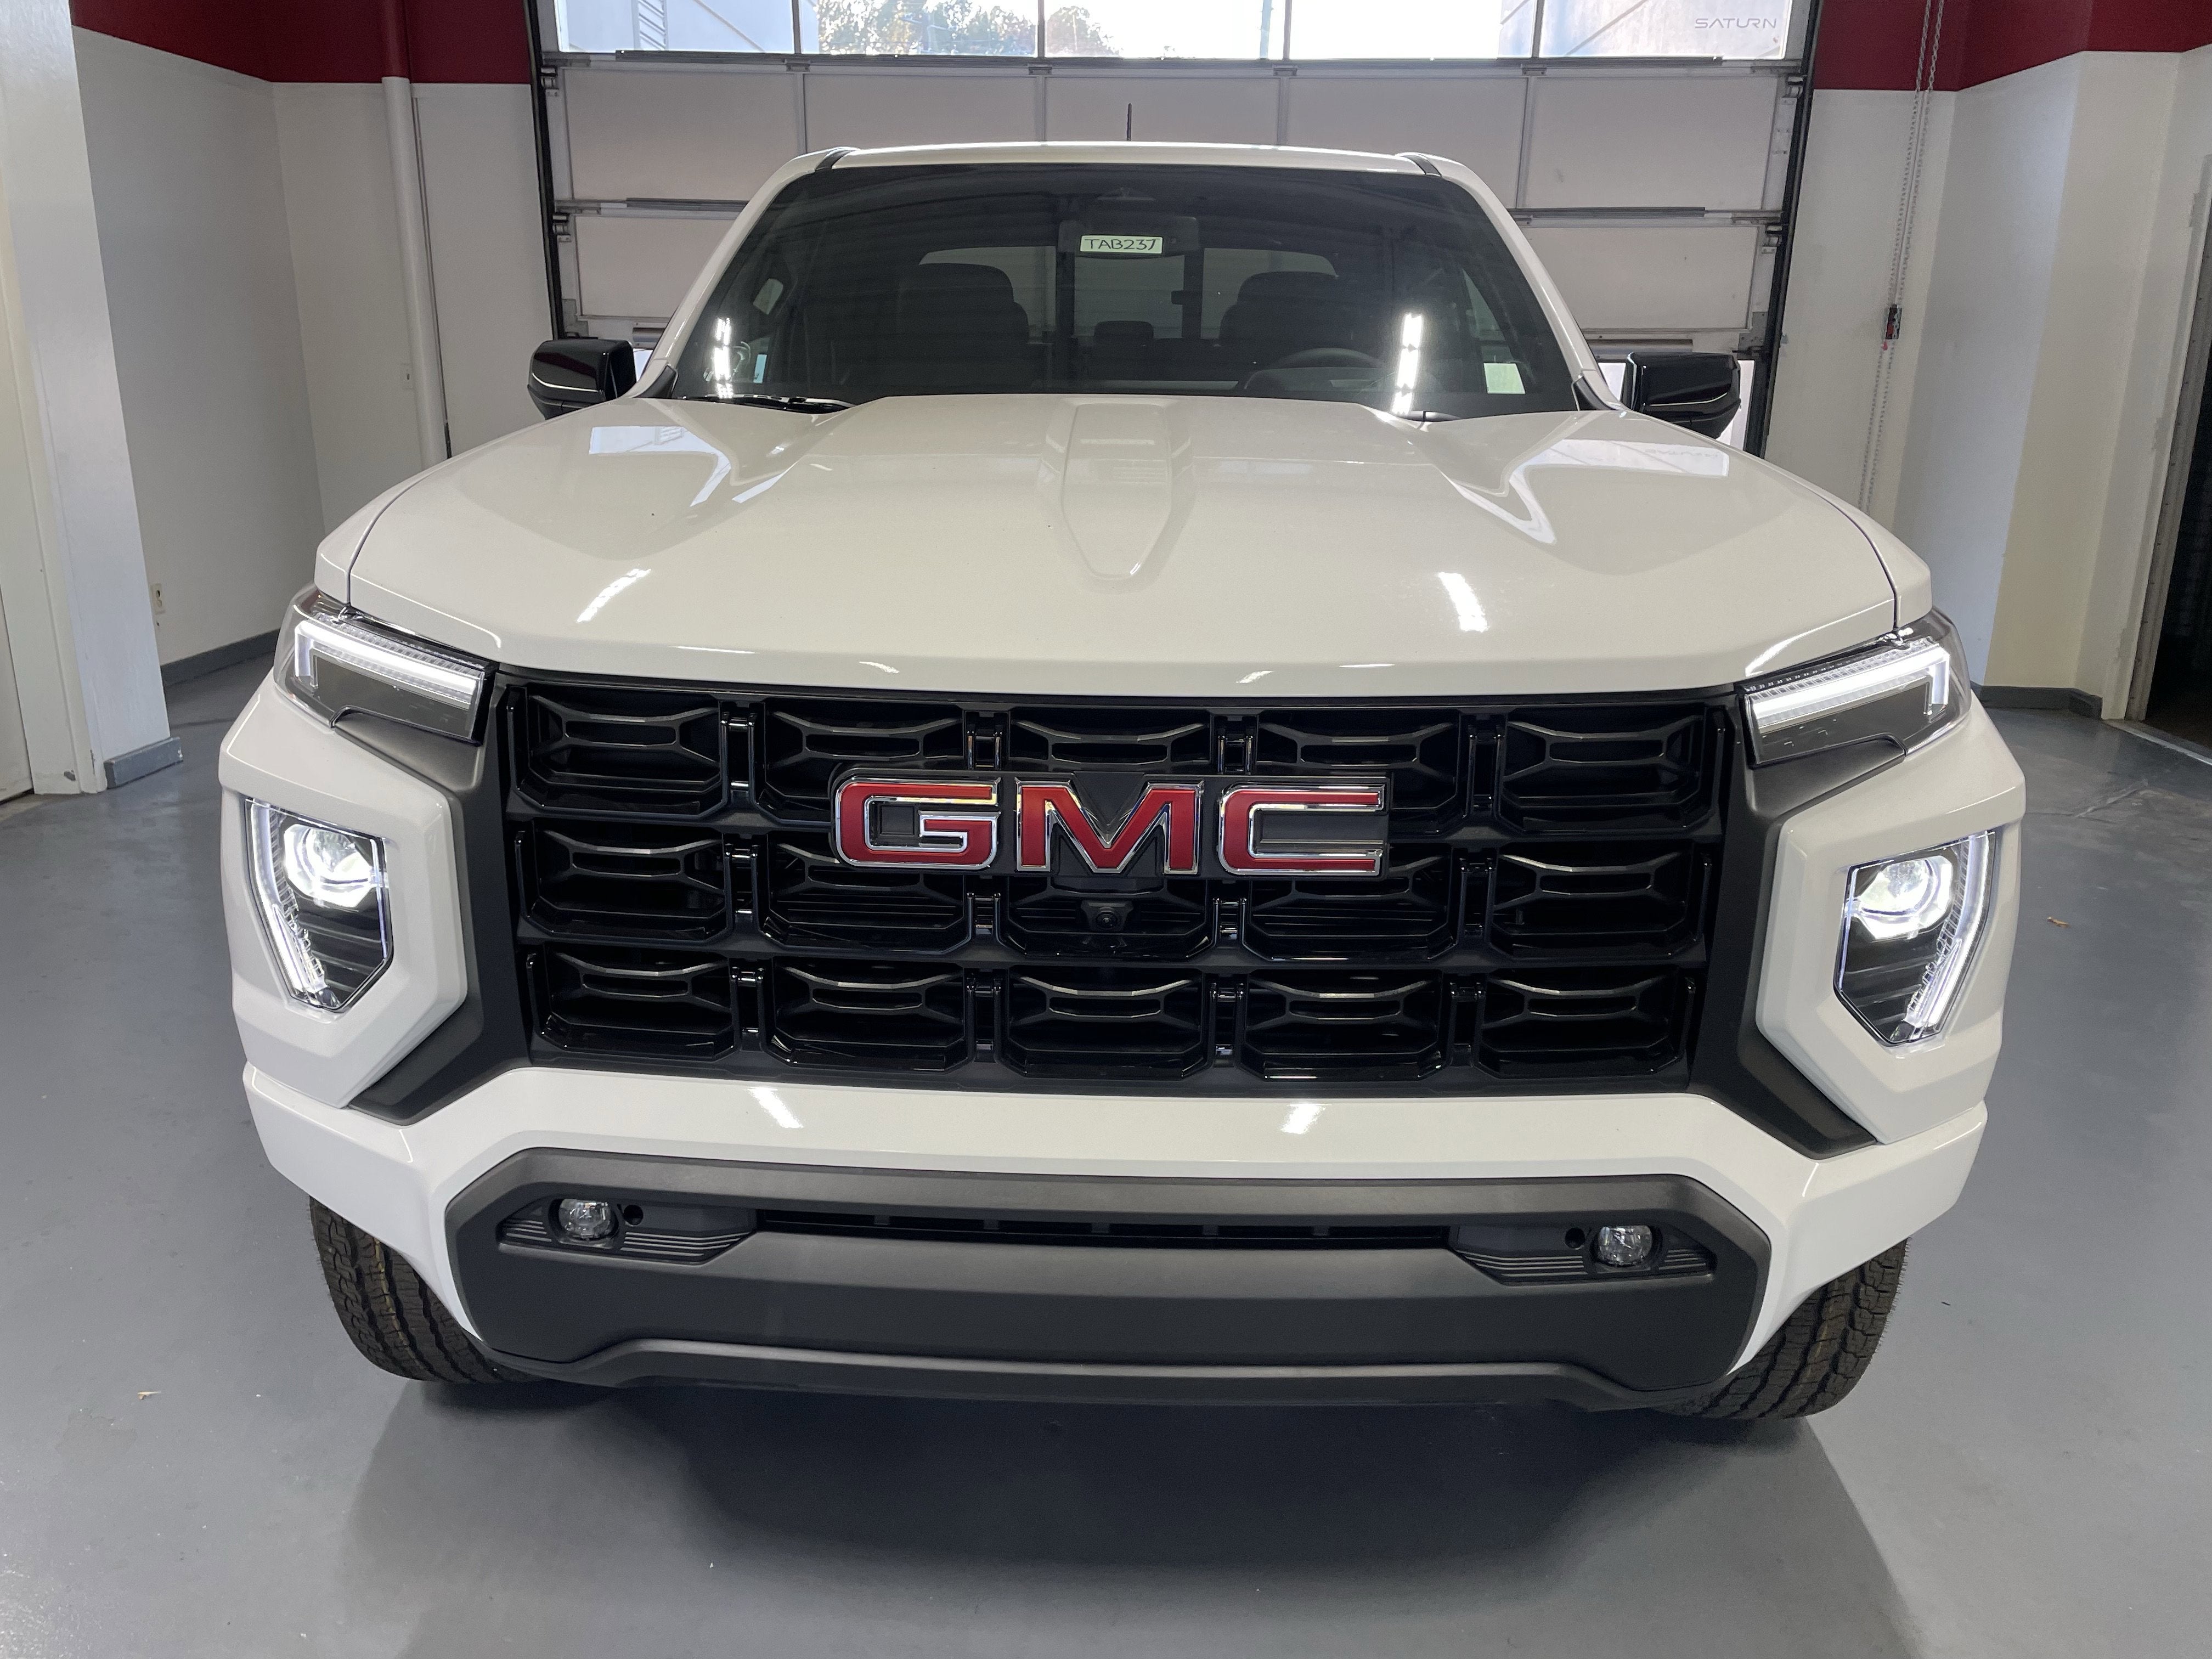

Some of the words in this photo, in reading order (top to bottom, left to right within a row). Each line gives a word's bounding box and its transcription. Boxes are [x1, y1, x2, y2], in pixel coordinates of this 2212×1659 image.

[1695, 18, 1777, 29] SATURN
[1084, 238, 1157, 251] TAB237
[835, 777, 1386, 876] GMC
